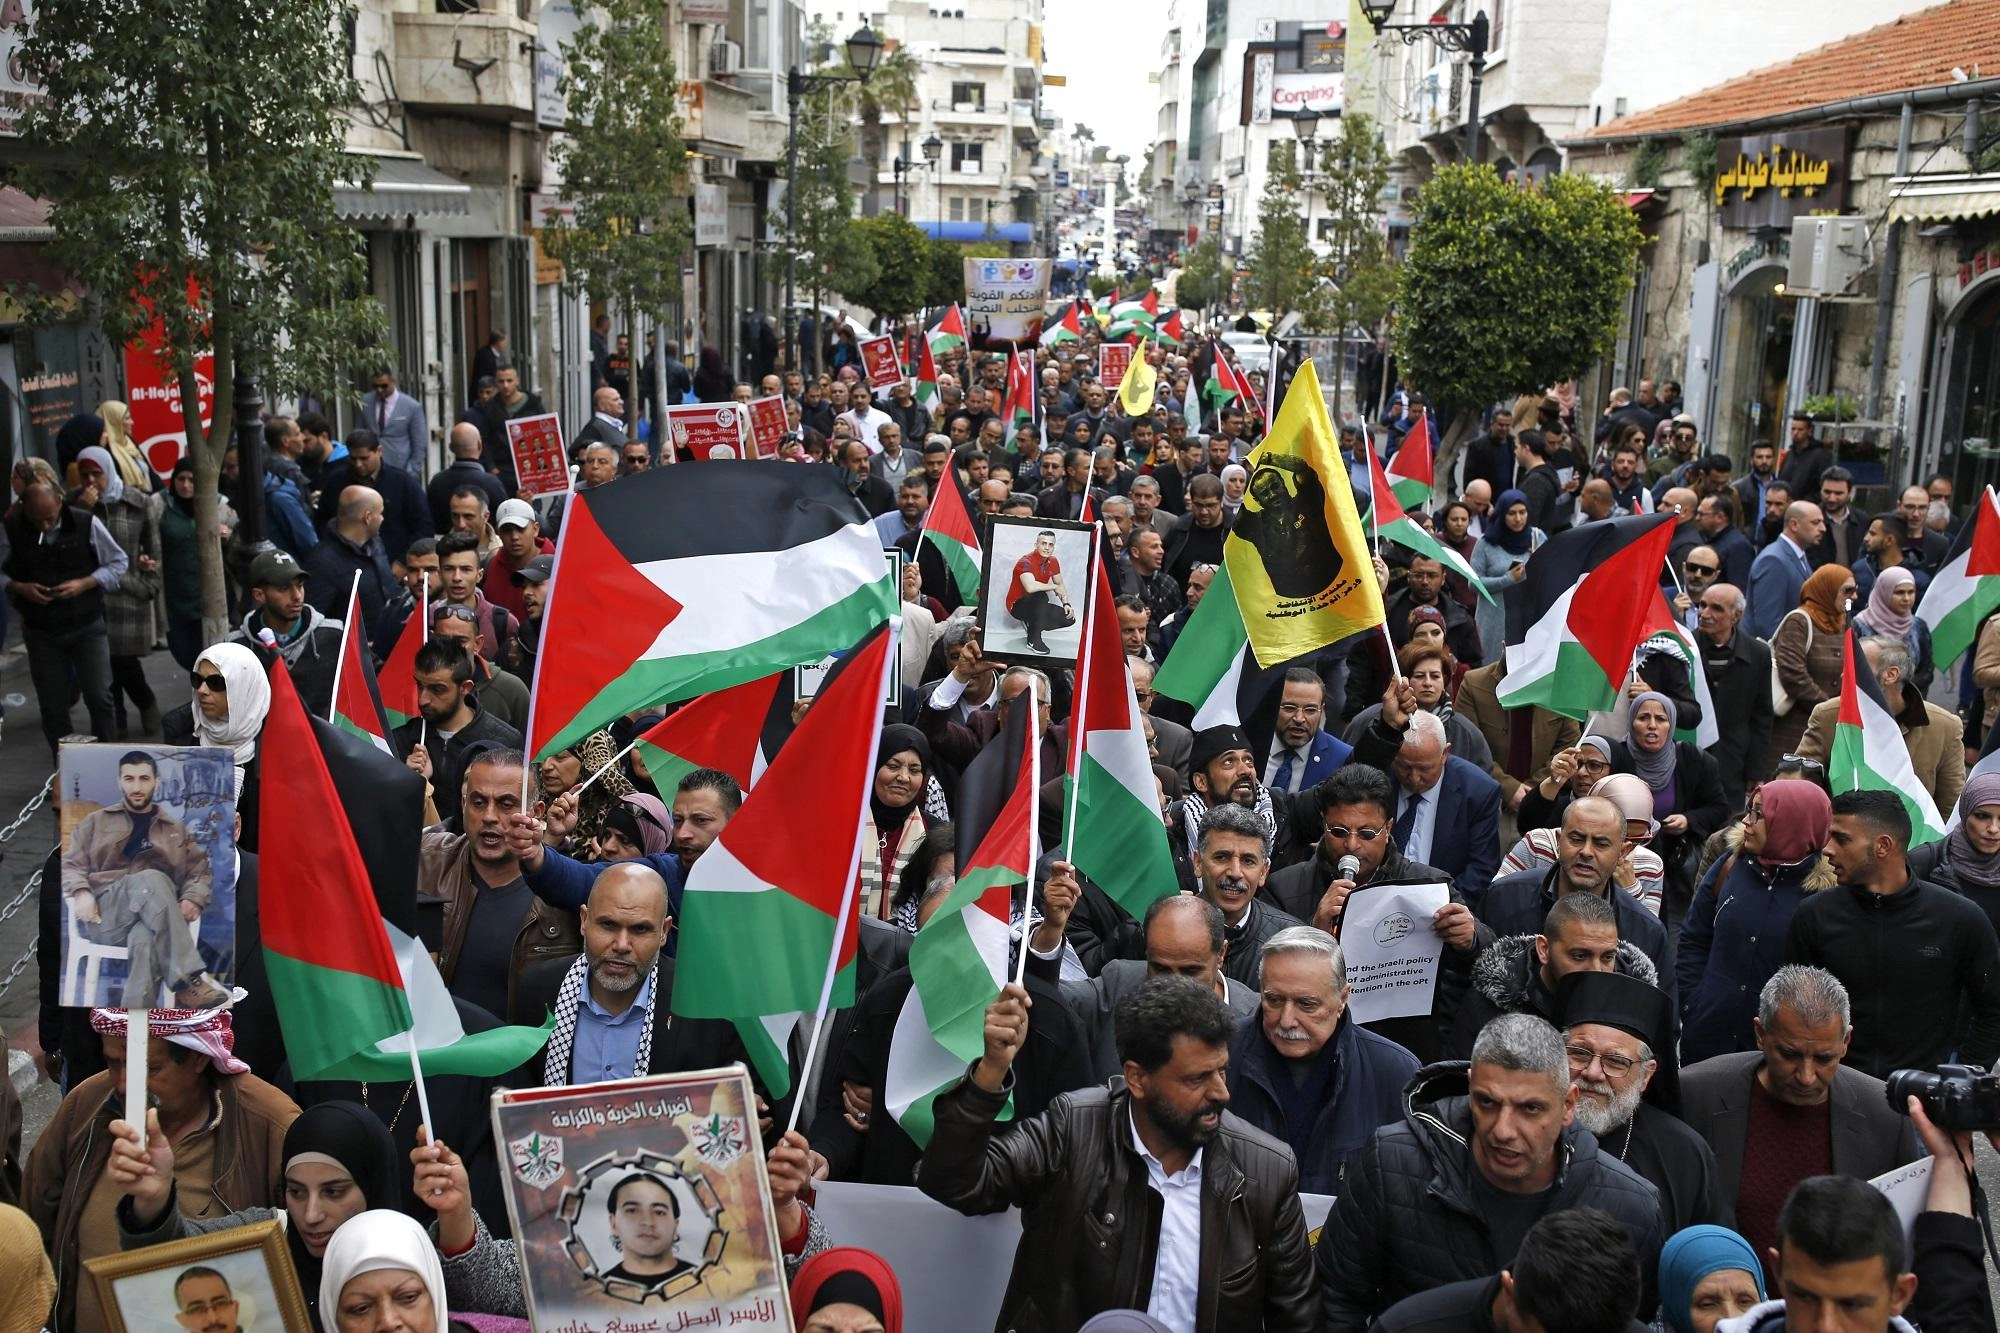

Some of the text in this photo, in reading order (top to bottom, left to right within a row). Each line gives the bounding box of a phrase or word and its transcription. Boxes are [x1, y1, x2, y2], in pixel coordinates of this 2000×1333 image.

[1274, 86, 1334, 104] Coming
[1770, 144, 1829, 198] صيدلية
[1265, 607, 1306, 620] الوطنية
[1383, 917, 1410, 926] PNGO
[1346, 956, 1434, 973] nd the Israeli policy
[1347, 967, 1424, 984] of administrative
[1348, 984, 1383, 995] tention
[1396, 979, 1411, 987] the
[1413, 977, 1429, 985] oPt
[551, 1107, 606, 1129] والكرامة
[606, 1101, 648, 1125] الحرية
[666, 1306, 721, 1333] البطل
[729, 1296, 776, 1327] الأسير
